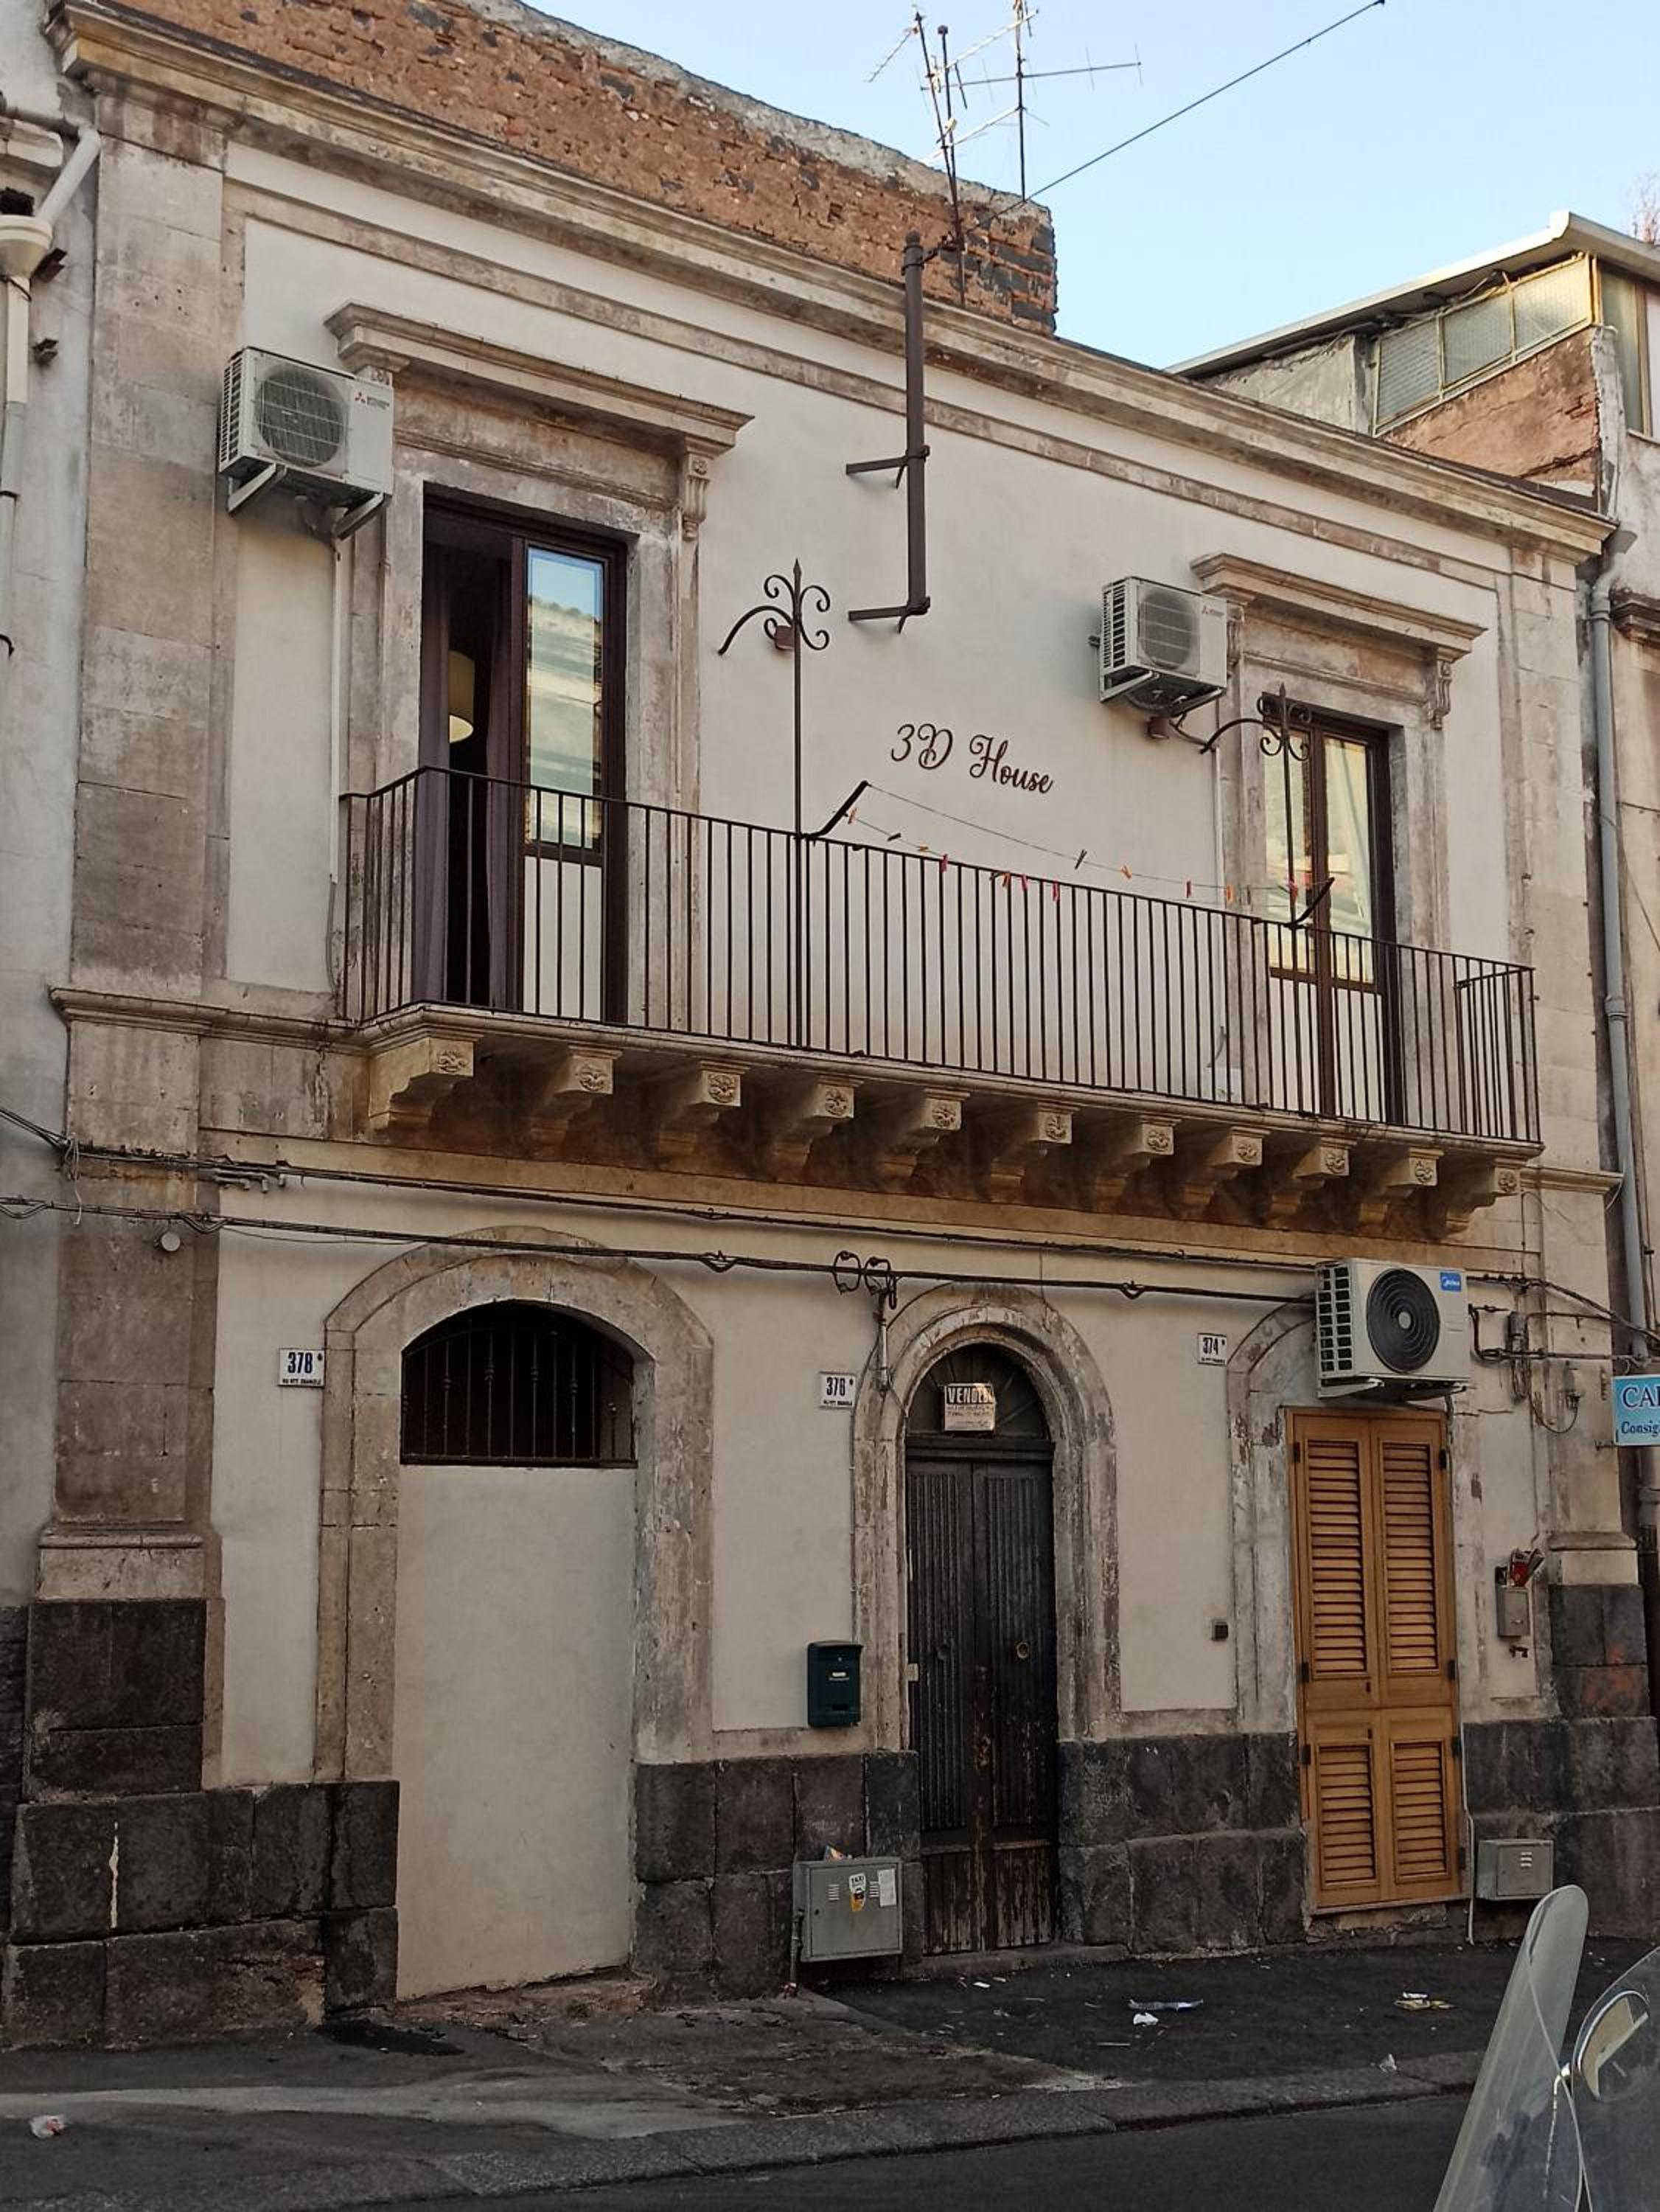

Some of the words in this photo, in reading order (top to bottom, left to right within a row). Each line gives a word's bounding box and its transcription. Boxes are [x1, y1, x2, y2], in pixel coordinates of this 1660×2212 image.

[890, 723, 953, 771] 3D
[969, 734, 1054, 794] House
[1202, 1337, 1218, 1355] 374
[287, 1352, 313, 1374] 378
[1621, 1420, 1660, 1437] Consig
